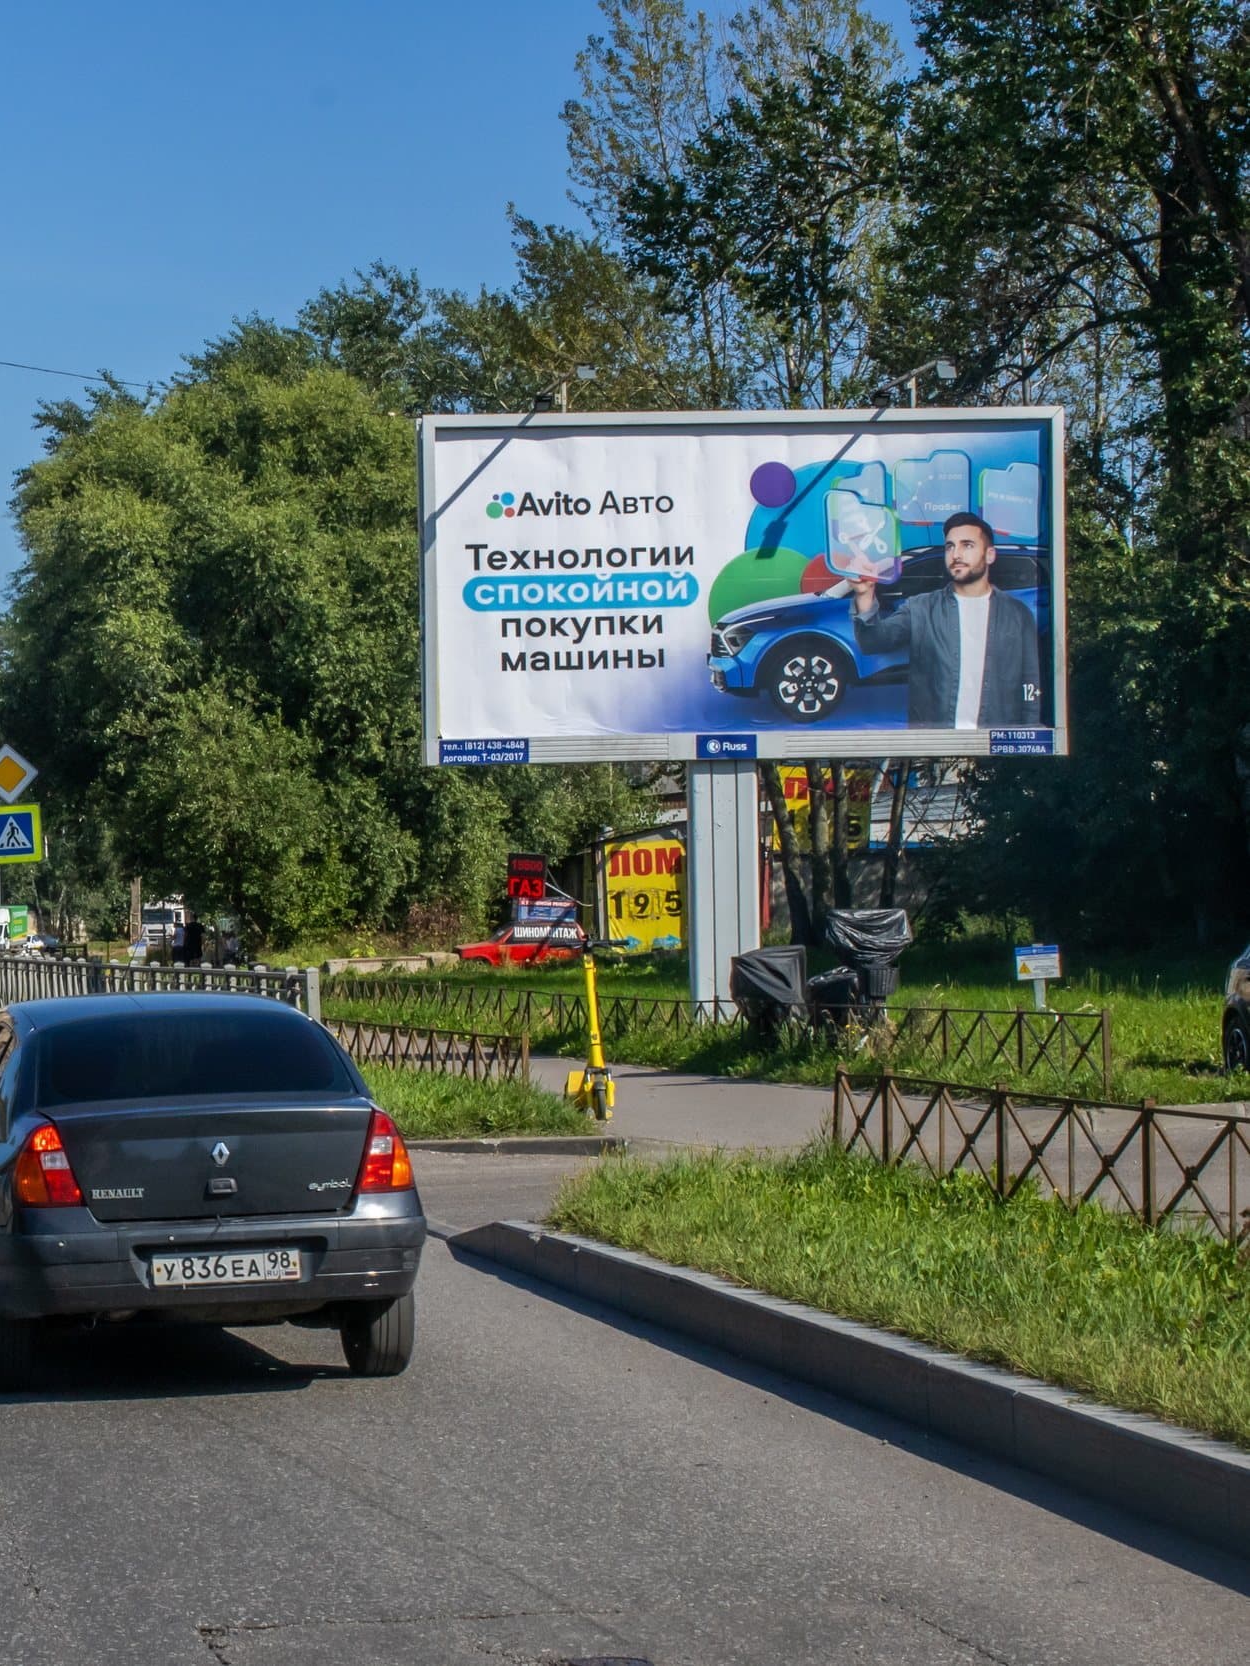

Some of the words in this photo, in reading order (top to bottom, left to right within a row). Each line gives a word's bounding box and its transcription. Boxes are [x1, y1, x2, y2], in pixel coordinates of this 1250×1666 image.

[516, 491, 591, 517] Avito
[599, 490, 674, 515] Авто
[465, 544, 694, 571] Технологии
[474, 571, 688, 605] спокойной
[501, 614, 663, 644] покупки
[501, 648, 665, 672] машины
[1022, 683, 1041, 701] 12+
[464, 741, 485, 750] (812)
[722, 741, 747, 751] Russ
[443, 754, 480, 764] договор:
[608, 847, 682, 877] ЛОМ
[509, 878, 543, 897] ГАЗ
[92, 1188, 144, 1199] RENAULT
[268, 1251, 291, 1269] 98
